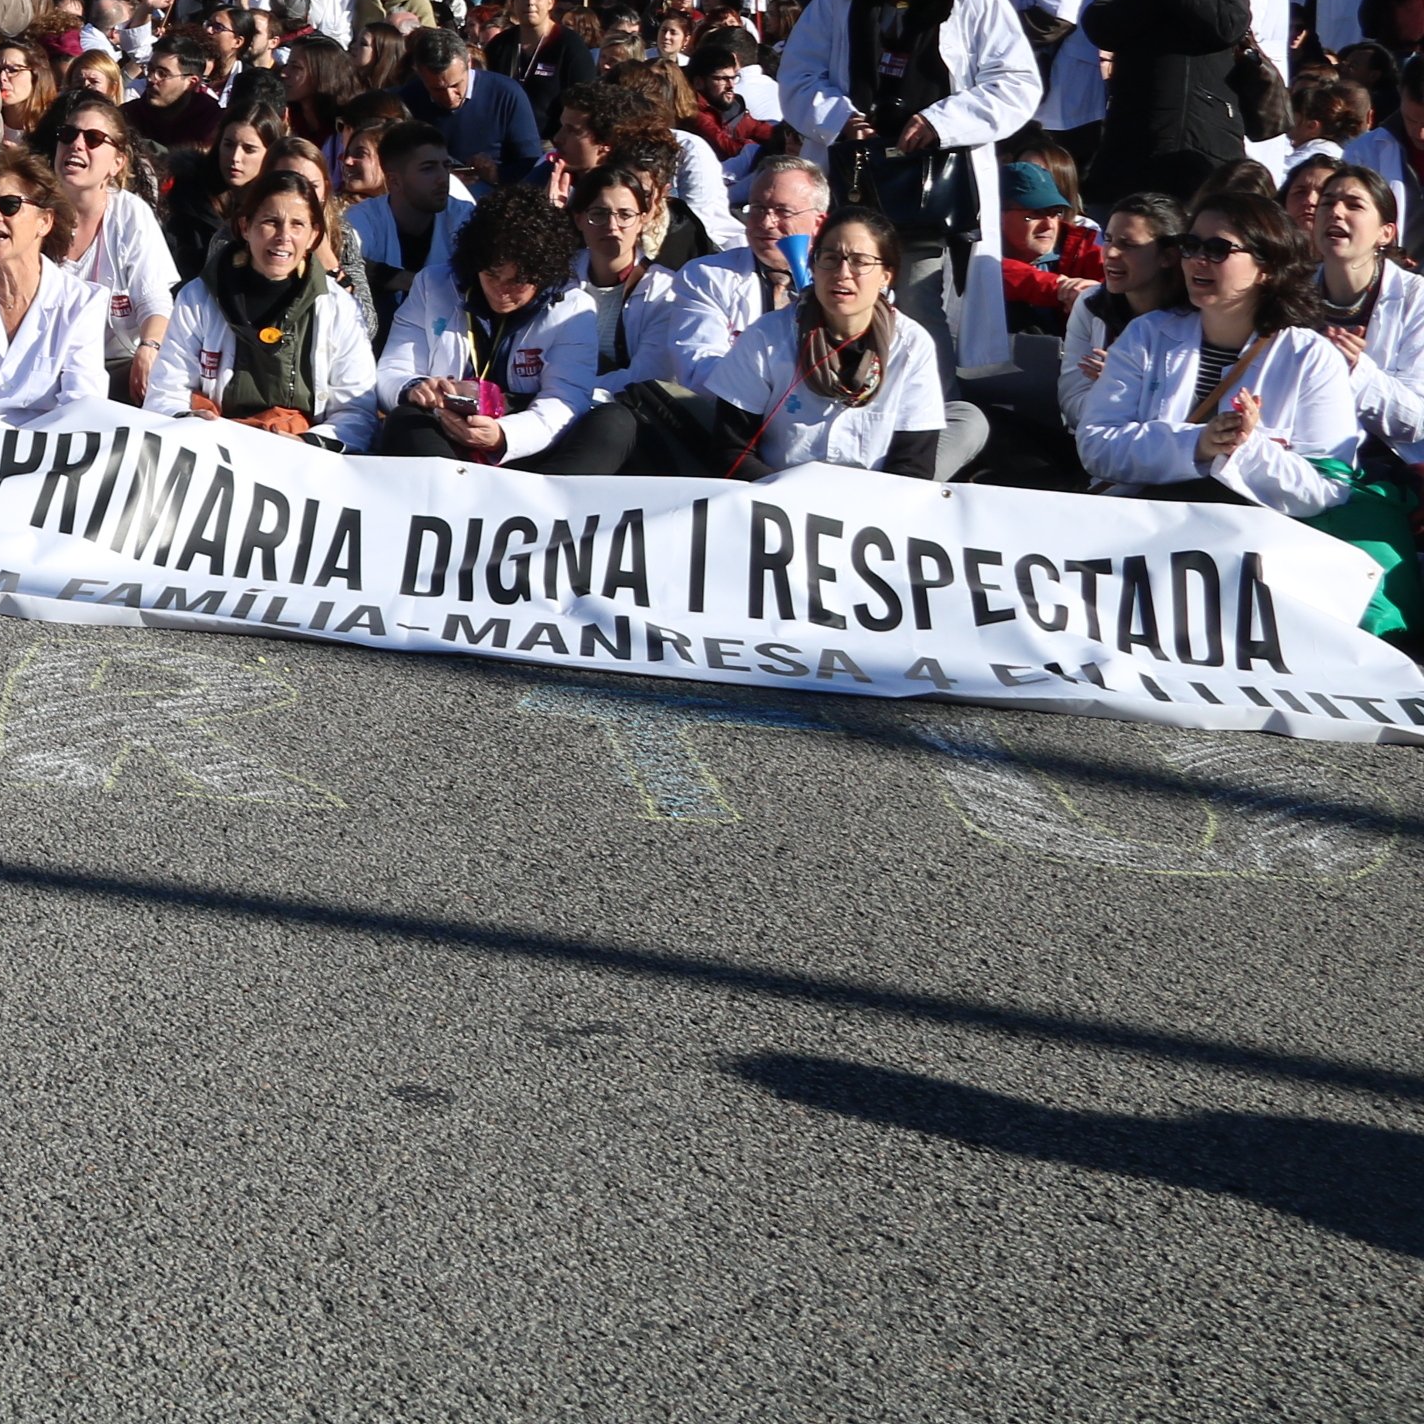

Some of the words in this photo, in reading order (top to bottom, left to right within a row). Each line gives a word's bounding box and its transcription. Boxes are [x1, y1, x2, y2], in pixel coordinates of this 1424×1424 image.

[400, 507, 651, 608] DIGNA
[688, 498, 708, 613] I
[749, 499, 1288, 675] RESPECTADA
[903, 657, 959, 690] 4
